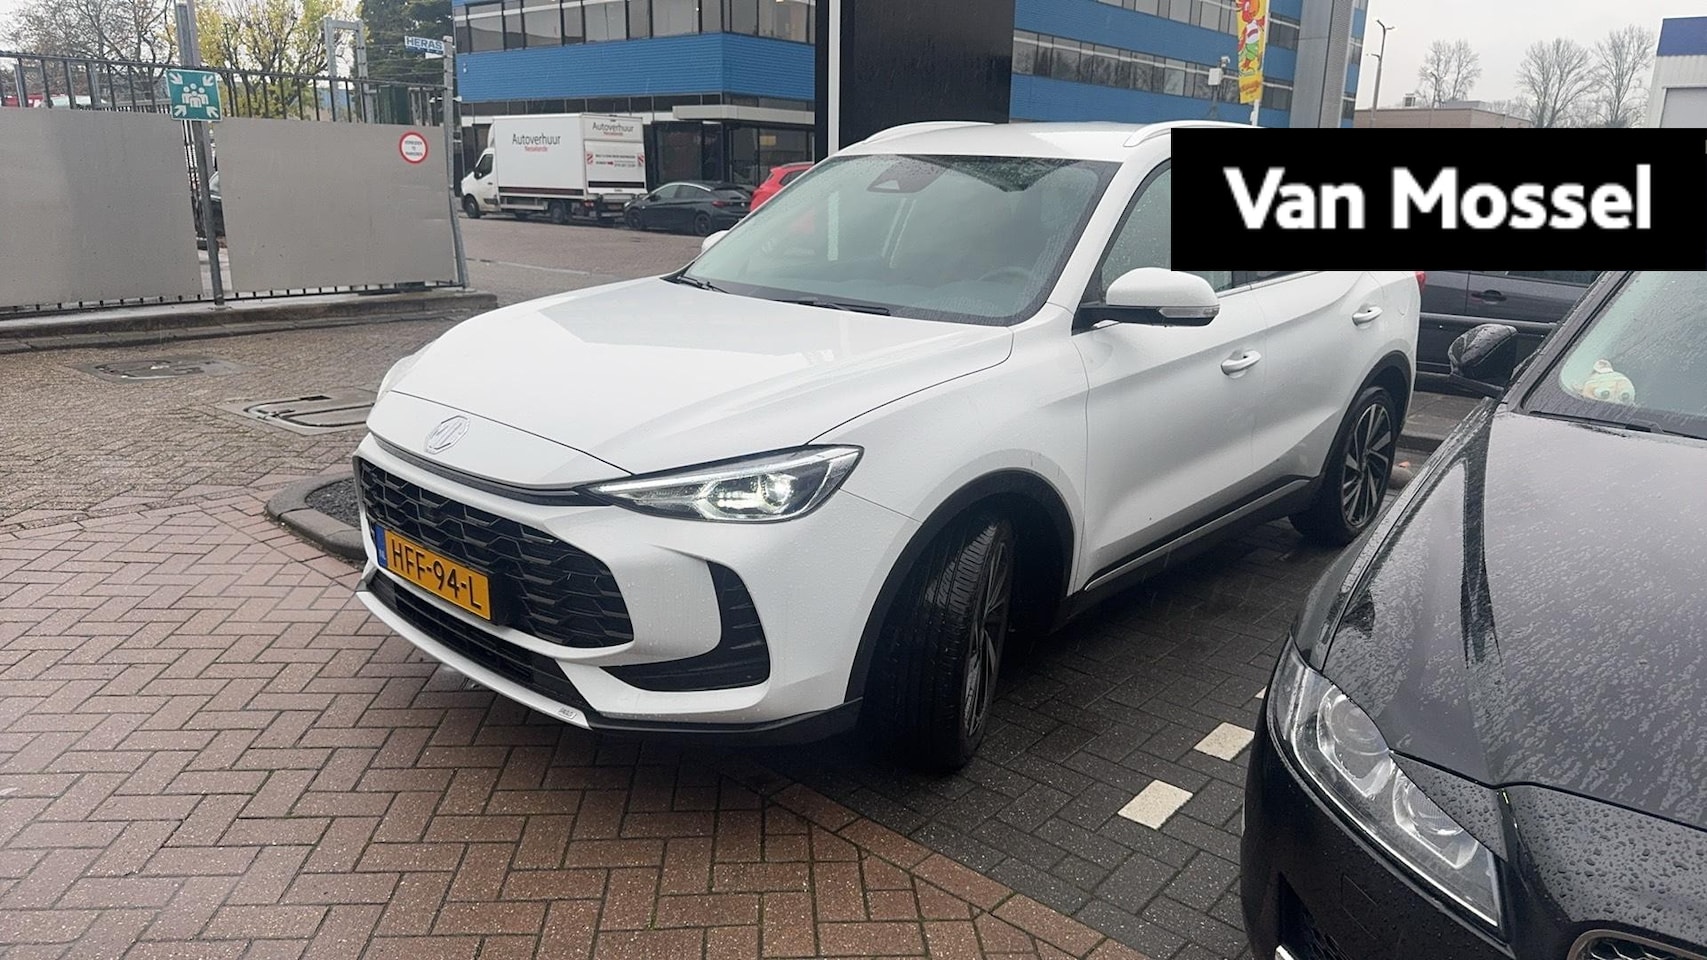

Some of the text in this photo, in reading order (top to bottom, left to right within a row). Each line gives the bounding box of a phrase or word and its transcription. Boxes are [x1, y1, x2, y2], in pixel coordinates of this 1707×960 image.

[406, 37, 443, 50] HERAS
[592, 121, 634, 132] Autoverhuur
[512, 132, 561, 145] Autoverhuur
[391, 538, 482, 610] HFF-94-L
